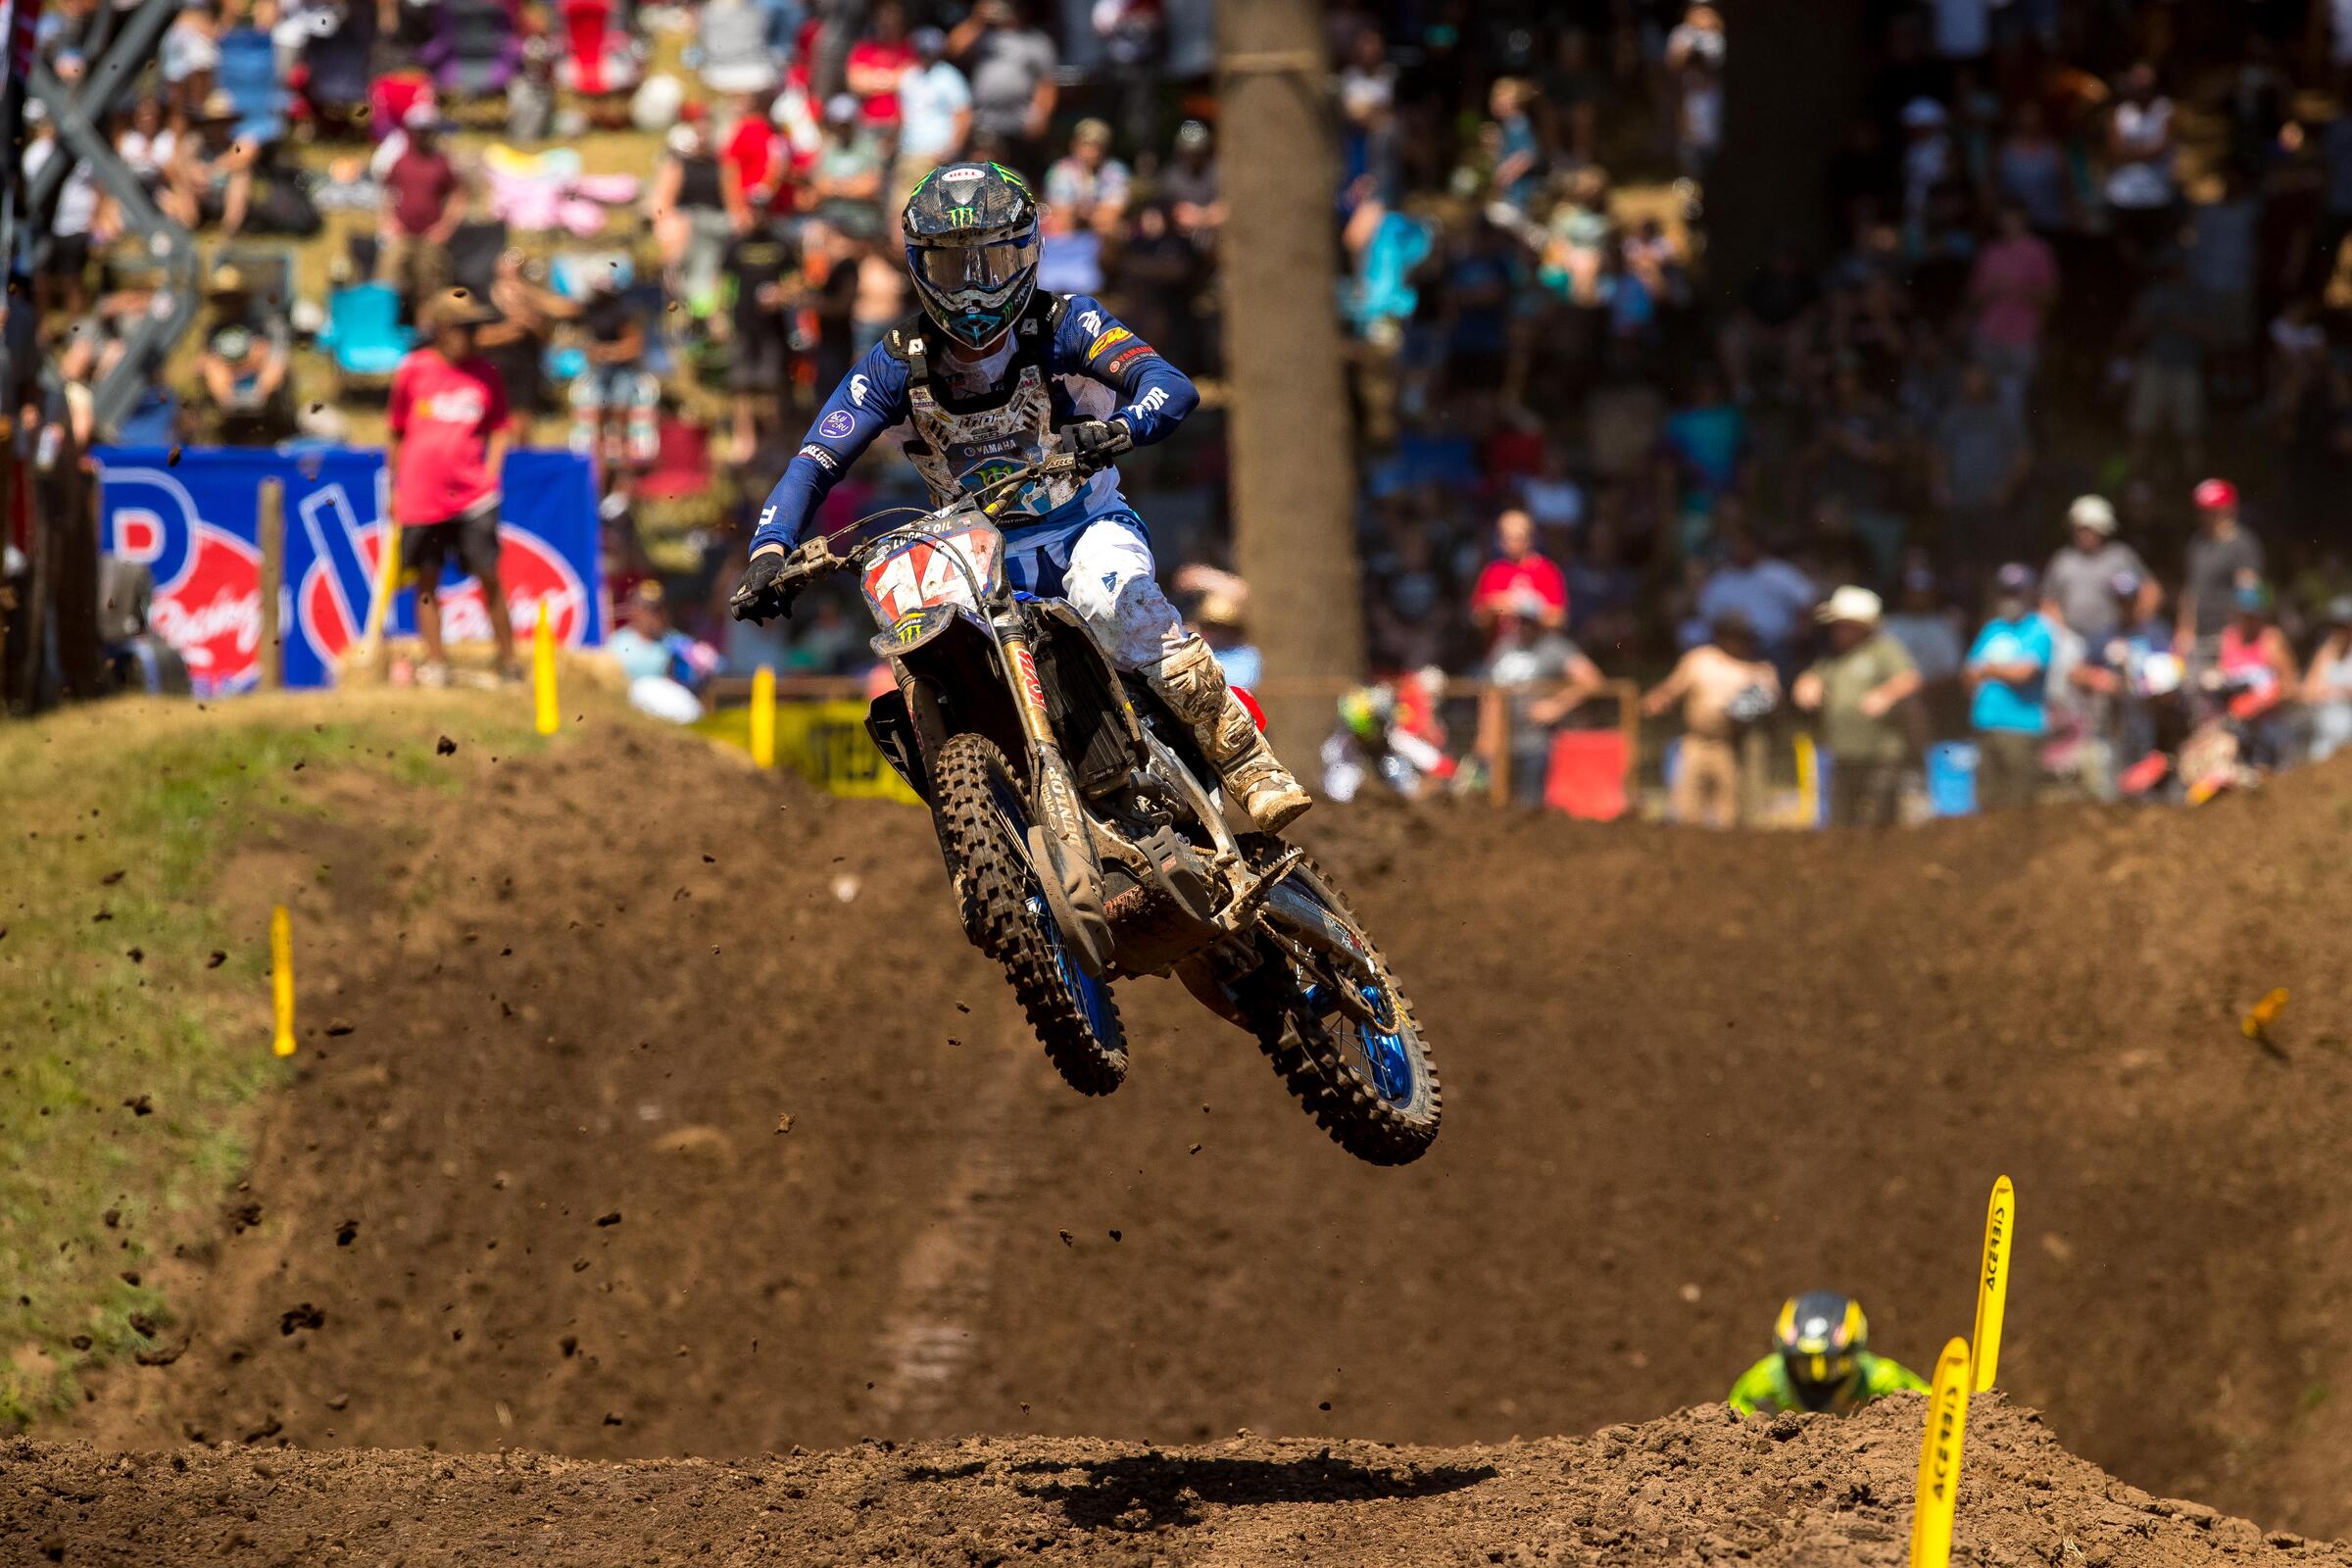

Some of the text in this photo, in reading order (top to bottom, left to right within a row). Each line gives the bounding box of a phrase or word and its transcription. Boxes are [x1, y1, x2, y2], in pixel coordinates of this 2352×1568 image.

[948, 170, 978, 179] BELL
[976, 438, 1017, 456] YAMAHA
[1044, 457, 1075, 470] ARC
[933, 520, 953, 534] OIL
[874, 532, 989, 616] 14
[896, 617, 922, 633] YAMAHA
[1985, 1206, 2006, 1292] ACERBIS
[1933, 1386, 1960, 1500] ACERBIS
